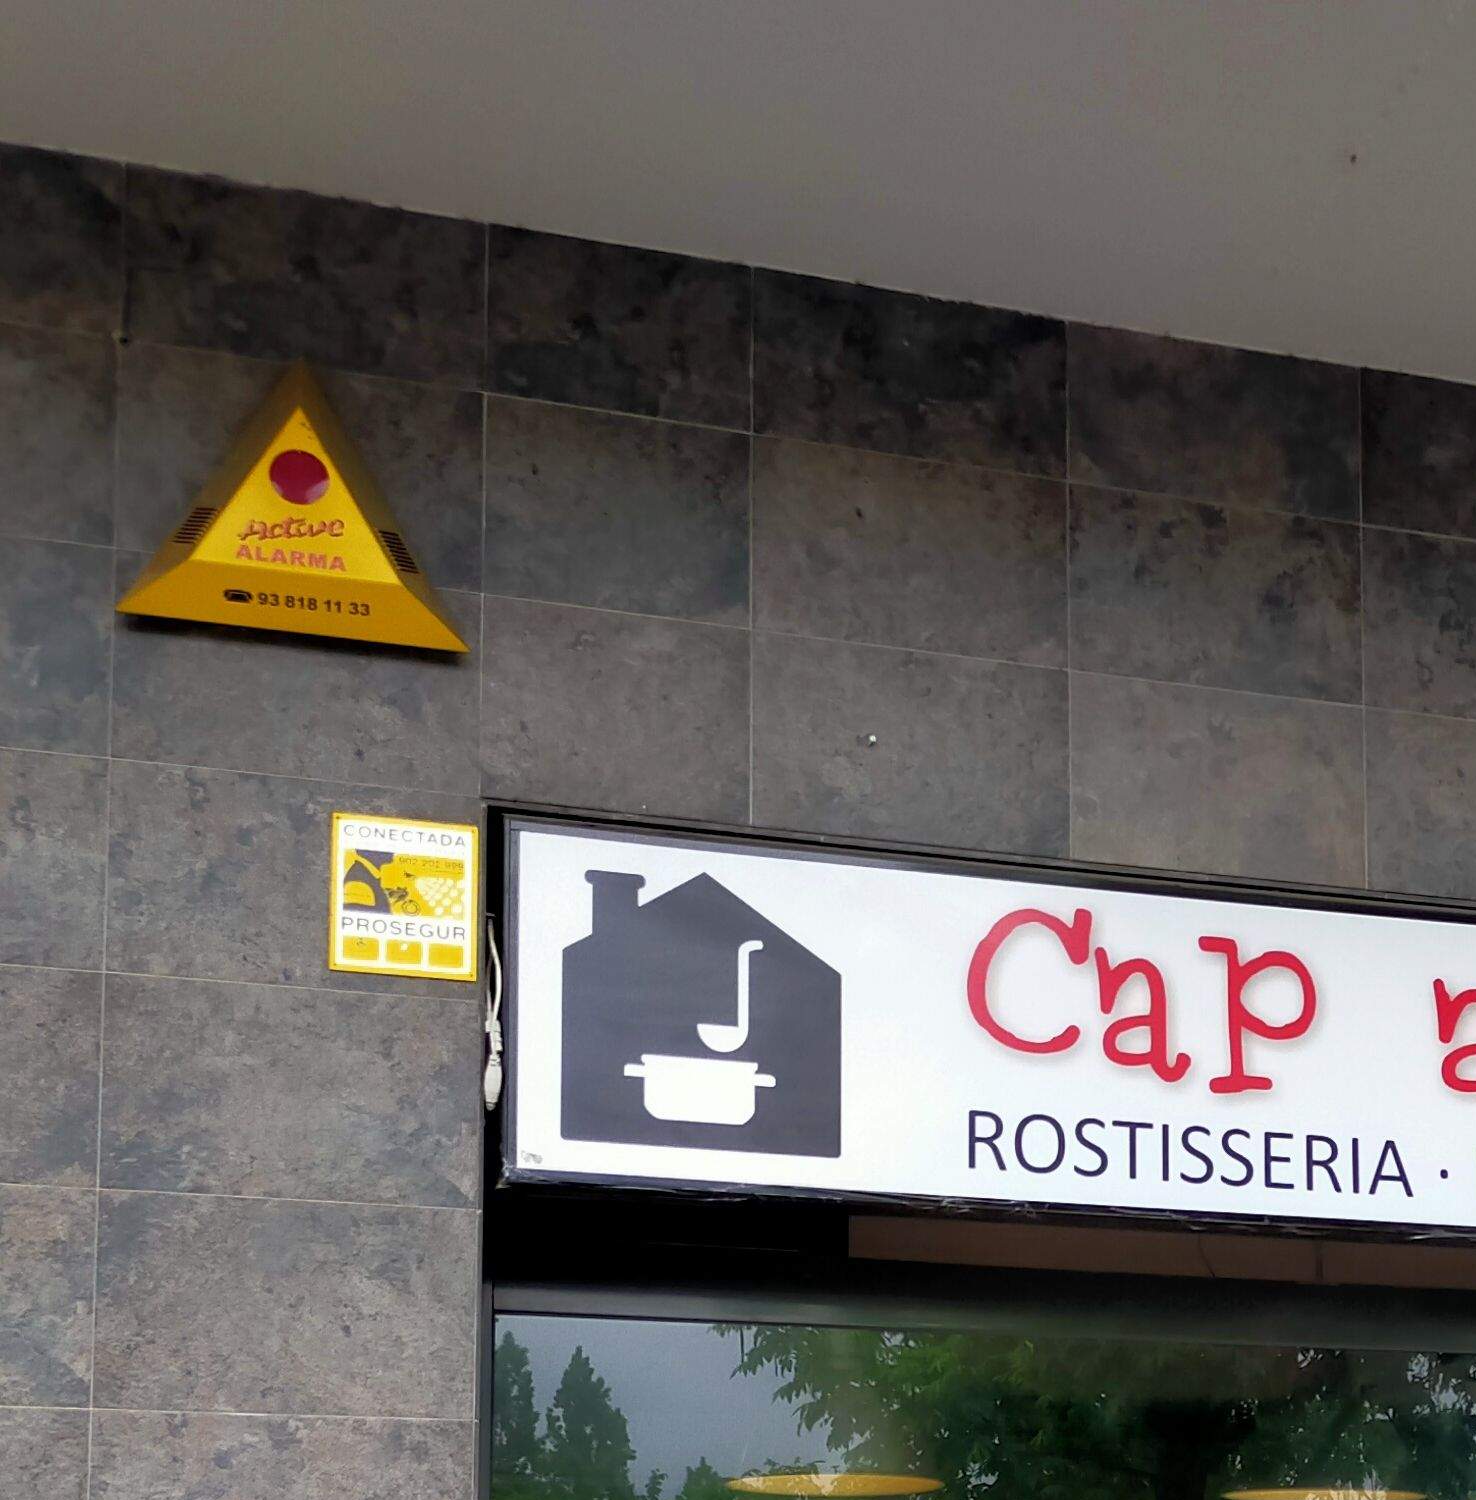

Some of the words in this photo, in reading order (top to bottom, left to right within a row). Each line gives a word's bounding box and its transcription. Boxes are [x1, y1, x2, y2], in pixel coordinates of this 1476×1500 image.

[237, 516, 345, 540] Active
[236, 544, 346, 571] ALARMA
[258, 592, 280, 607] 93
[285, 595, 317, 611] 818
[324, 600, 341, 613] 11
[349, 602, 370, 616] 33
[344, 824, 466, 847] CONECTADA
[342, 916, 466, 940] PROSEGUR
[965, 907, 1317, 1094] Cap
[965, 1108, 1414, 1198] ROSTISSERIA
